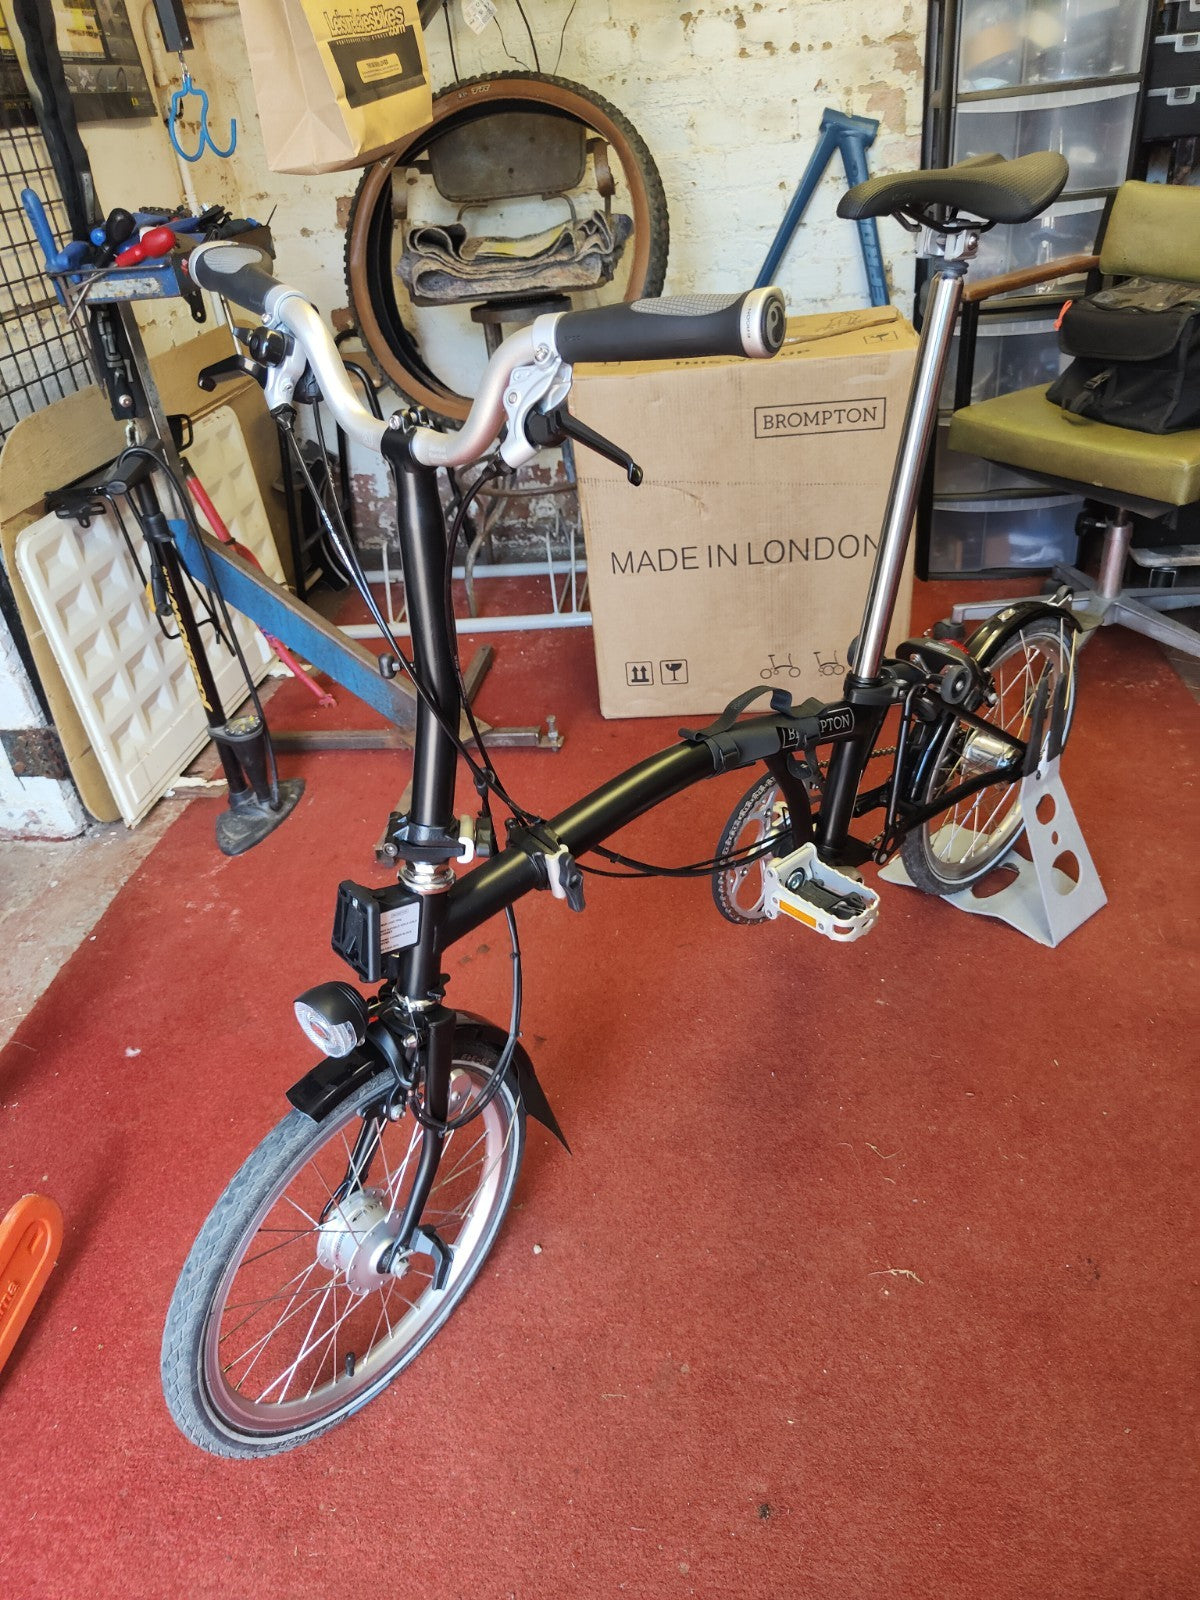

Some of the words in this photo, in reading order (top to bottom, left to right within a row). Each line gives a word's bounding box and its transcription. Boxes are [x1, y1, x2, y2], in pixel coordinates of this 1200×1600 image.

[323, 4, 405, 37] LeisLakesBikes
[763, 406, 877, 430] BROMPTON
[611, 546, 699, 574] MADE
[708, 543, 737, 568] IN
[748, 534, 878, 565] LONDON
[788, 714, 850, 741] BPTON
